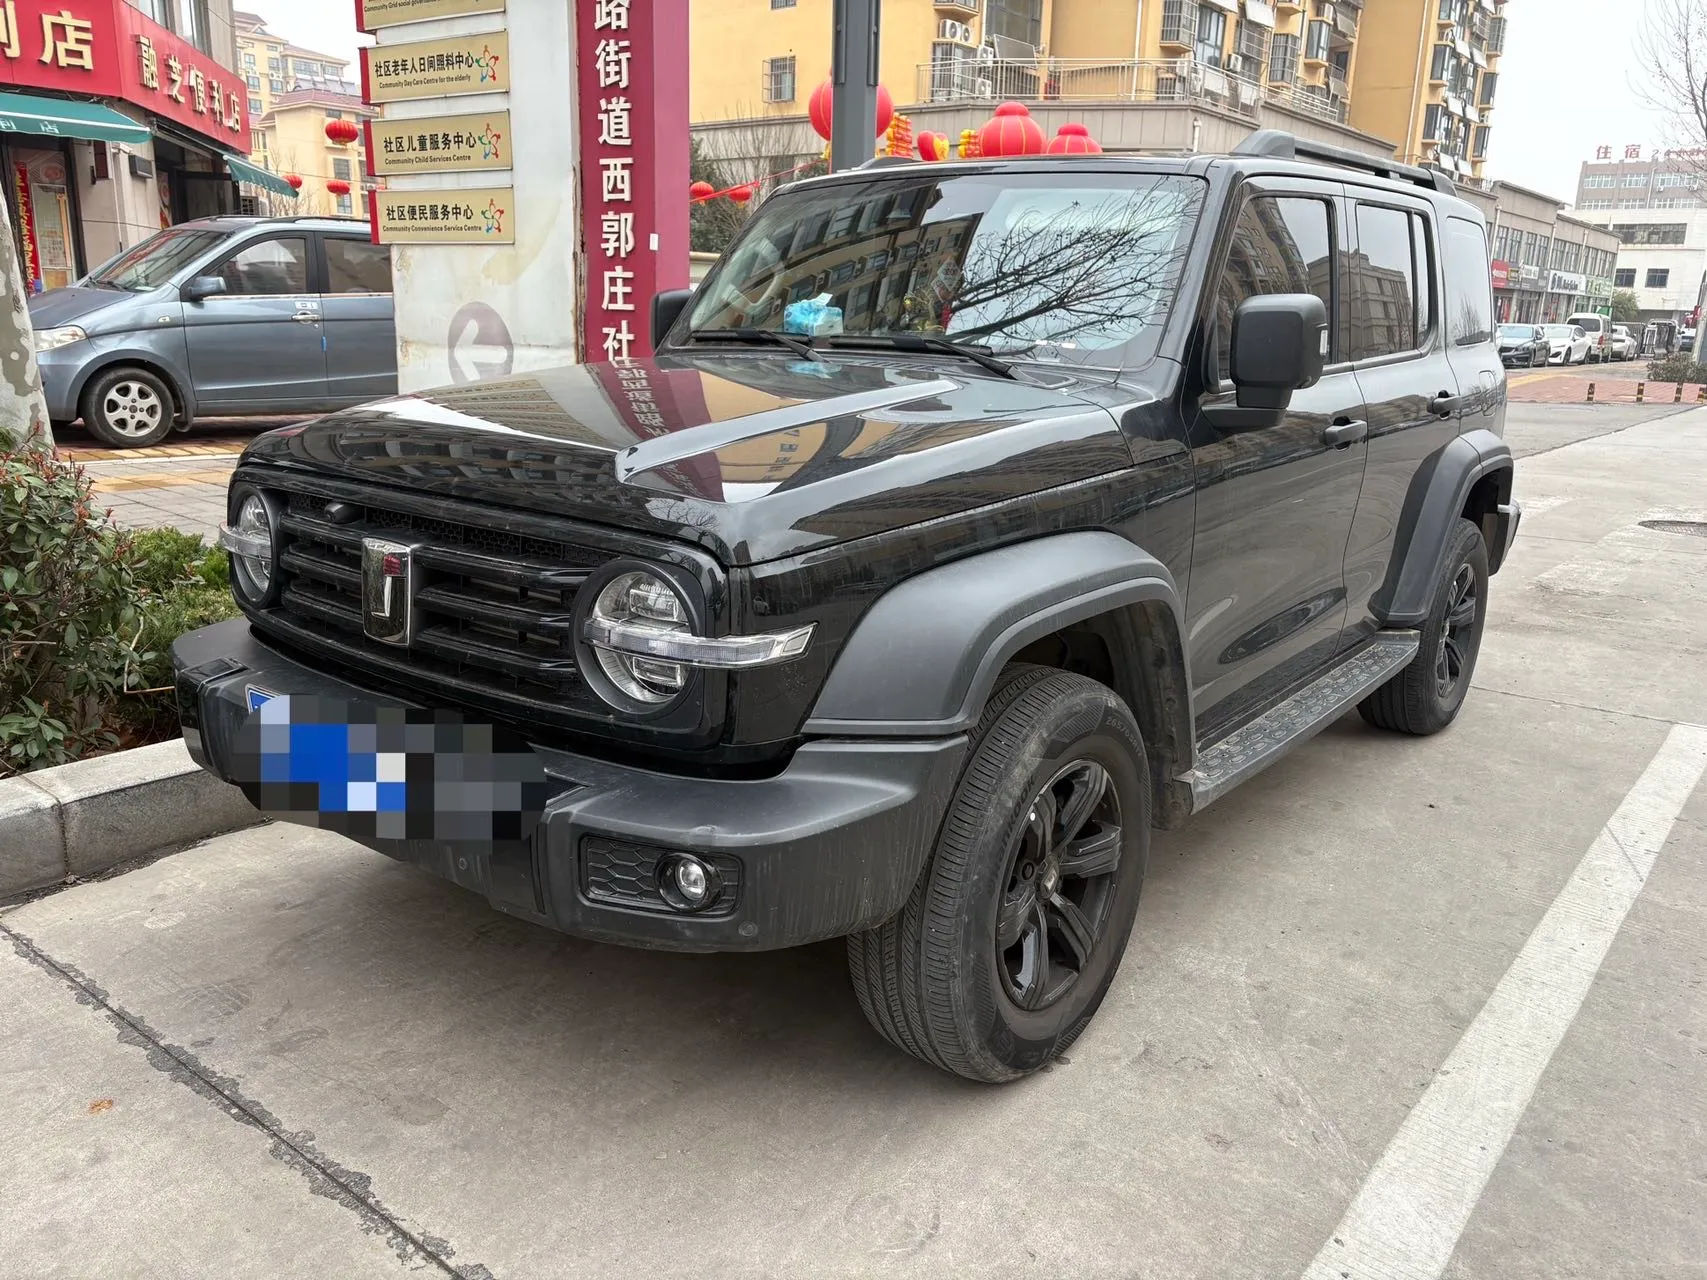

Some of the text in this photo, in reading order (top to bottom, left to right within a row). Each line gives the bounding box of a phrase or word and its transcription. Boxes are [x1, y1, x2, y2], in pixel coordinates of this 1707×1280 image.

[375, 51, 475, 78] 社区老年人日间照料中心
[136, 34, 241, 132] 融芝便利店
[379, 81, 404, 89] Community
[404, 79, 413, 87] Day
[455, 74, 471, 82] elderly
[384, 131, 476, 154] 社区儿童服务中心
[385, 157, 414, 165] Community
[386, 203, 474, 221] 社区便民服务中心
[444, 224, 463, 232] Service
